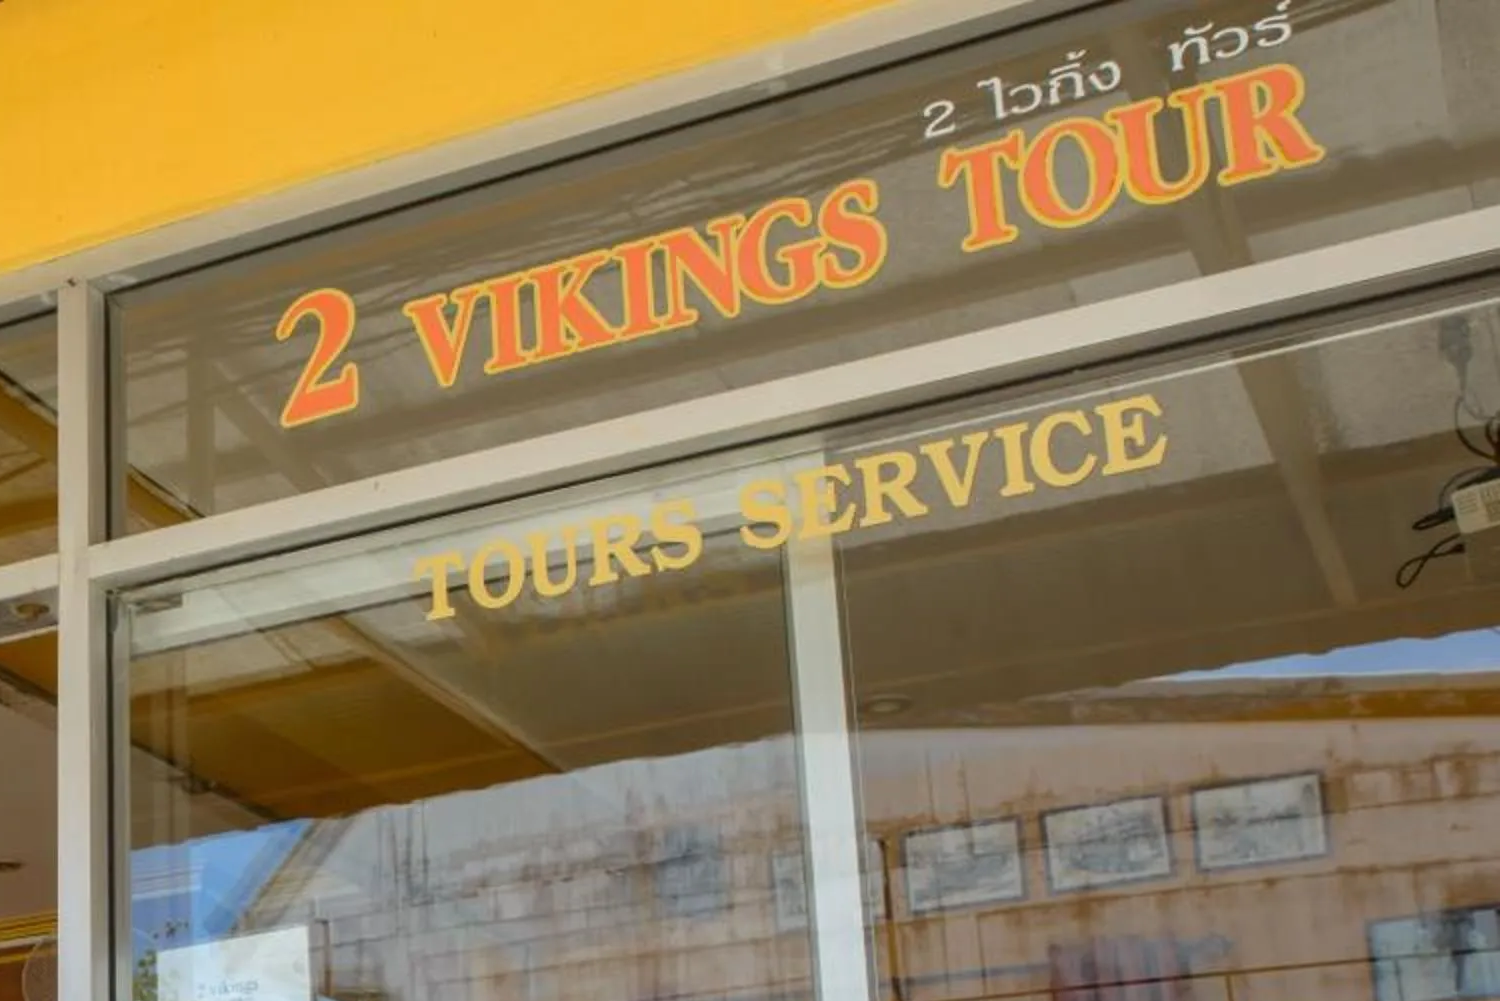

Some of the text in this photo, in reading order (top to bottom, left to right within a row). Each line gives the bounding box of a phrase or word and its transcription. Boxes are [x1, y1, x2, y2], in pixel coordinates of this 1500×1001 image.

[922, 99, 956, 139] 2
[976, 48, 1122, 120] ไวกิ้ง
[274, 61, 1325, 429] 2 VIKINGS TOUR
[412, 394, 1168, 621] TOURS SERVICE
